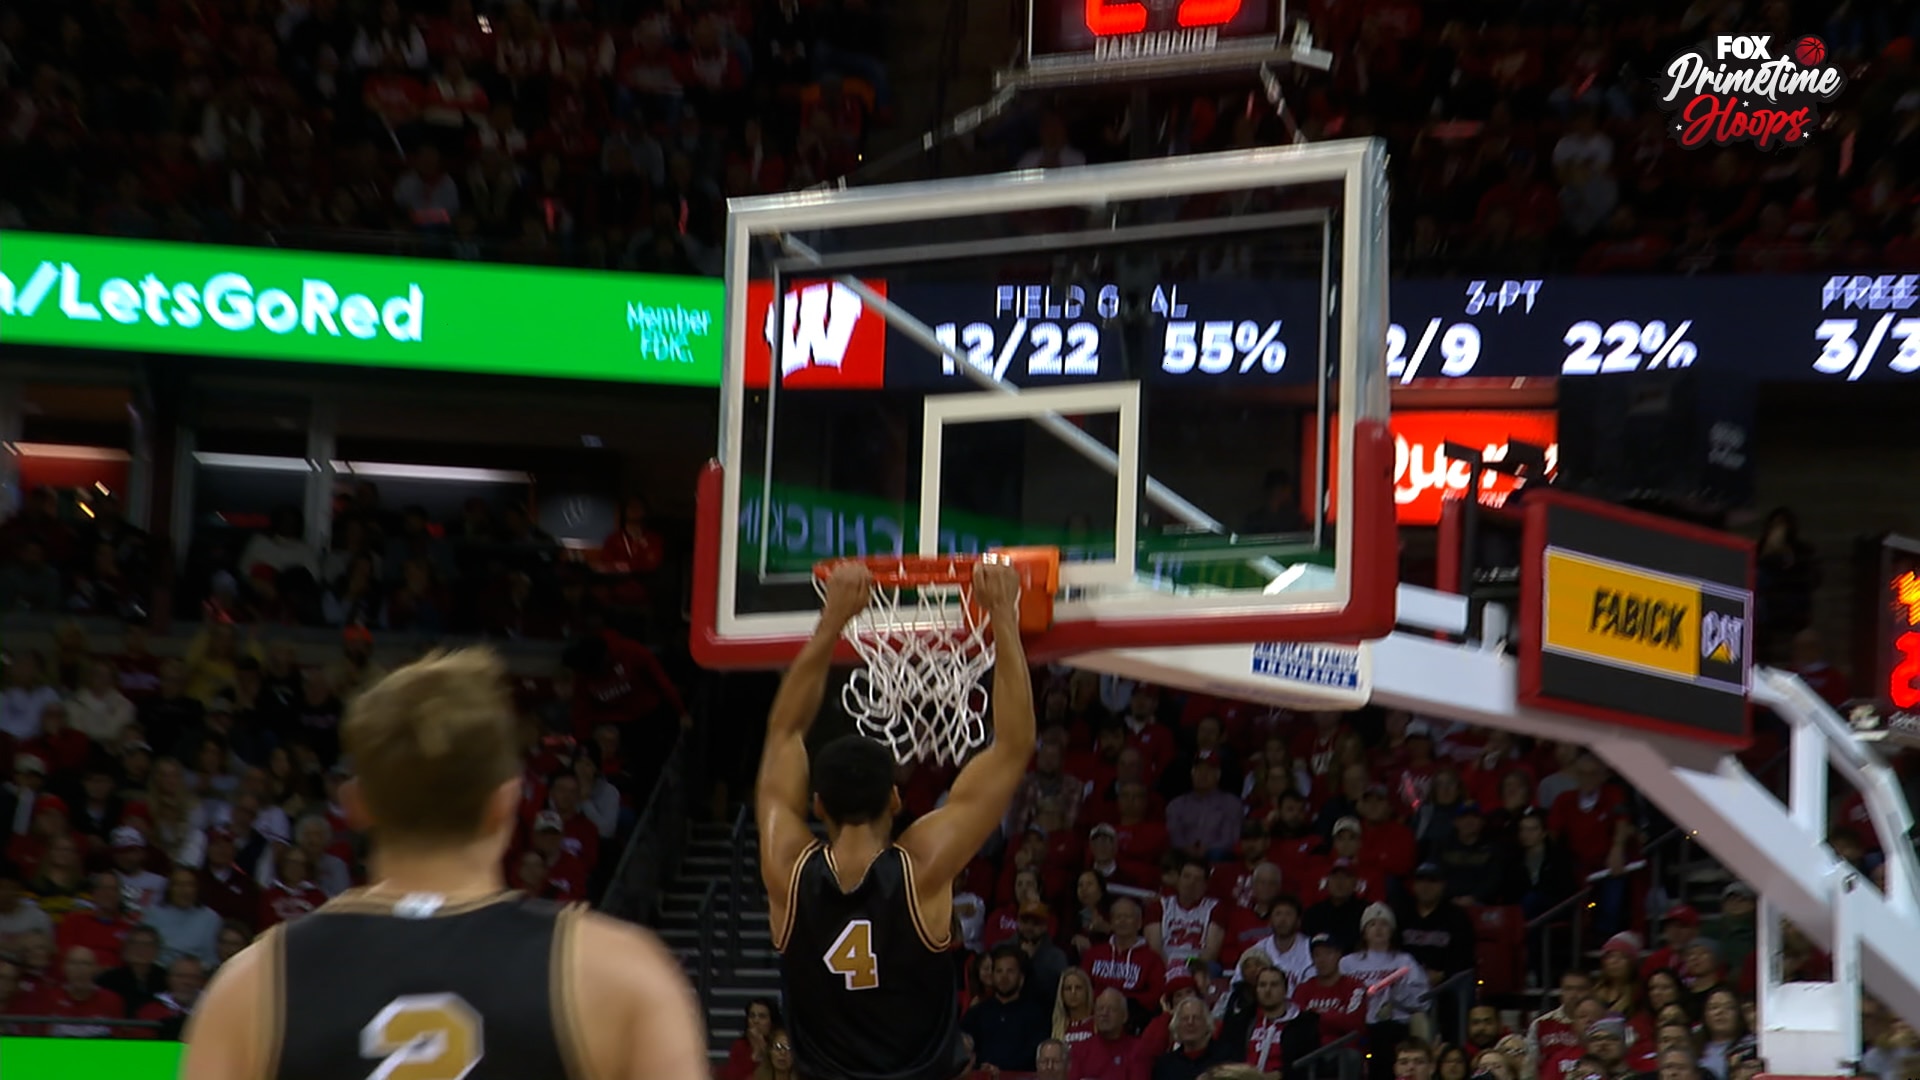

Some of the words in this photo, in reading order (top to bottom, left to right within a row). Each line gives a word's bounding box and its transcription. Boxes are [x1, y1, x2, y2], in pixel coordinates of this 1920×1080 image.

[626, 300, 712, 337] Member
[996, 284, 1085, 319] FIELD
[1097, 284, 1189, 319] GAL
[1465, 279, 1544, 316] 3-PT
[1822, 274, 1920, 311] FREE
[935, 317, 1101, 383] 12/22
[1161, 319, 1288, 375] 55%
[1561, 319, 1698, 375] 22%
[1811, 312, 1920, 382] 3/3
[1588, 586, 1689, 651] FABICK
[1702, 610, 1744, 664] CAT
[823, 919, 880, 991] 4
[359, 992, 485, 1080] 2
